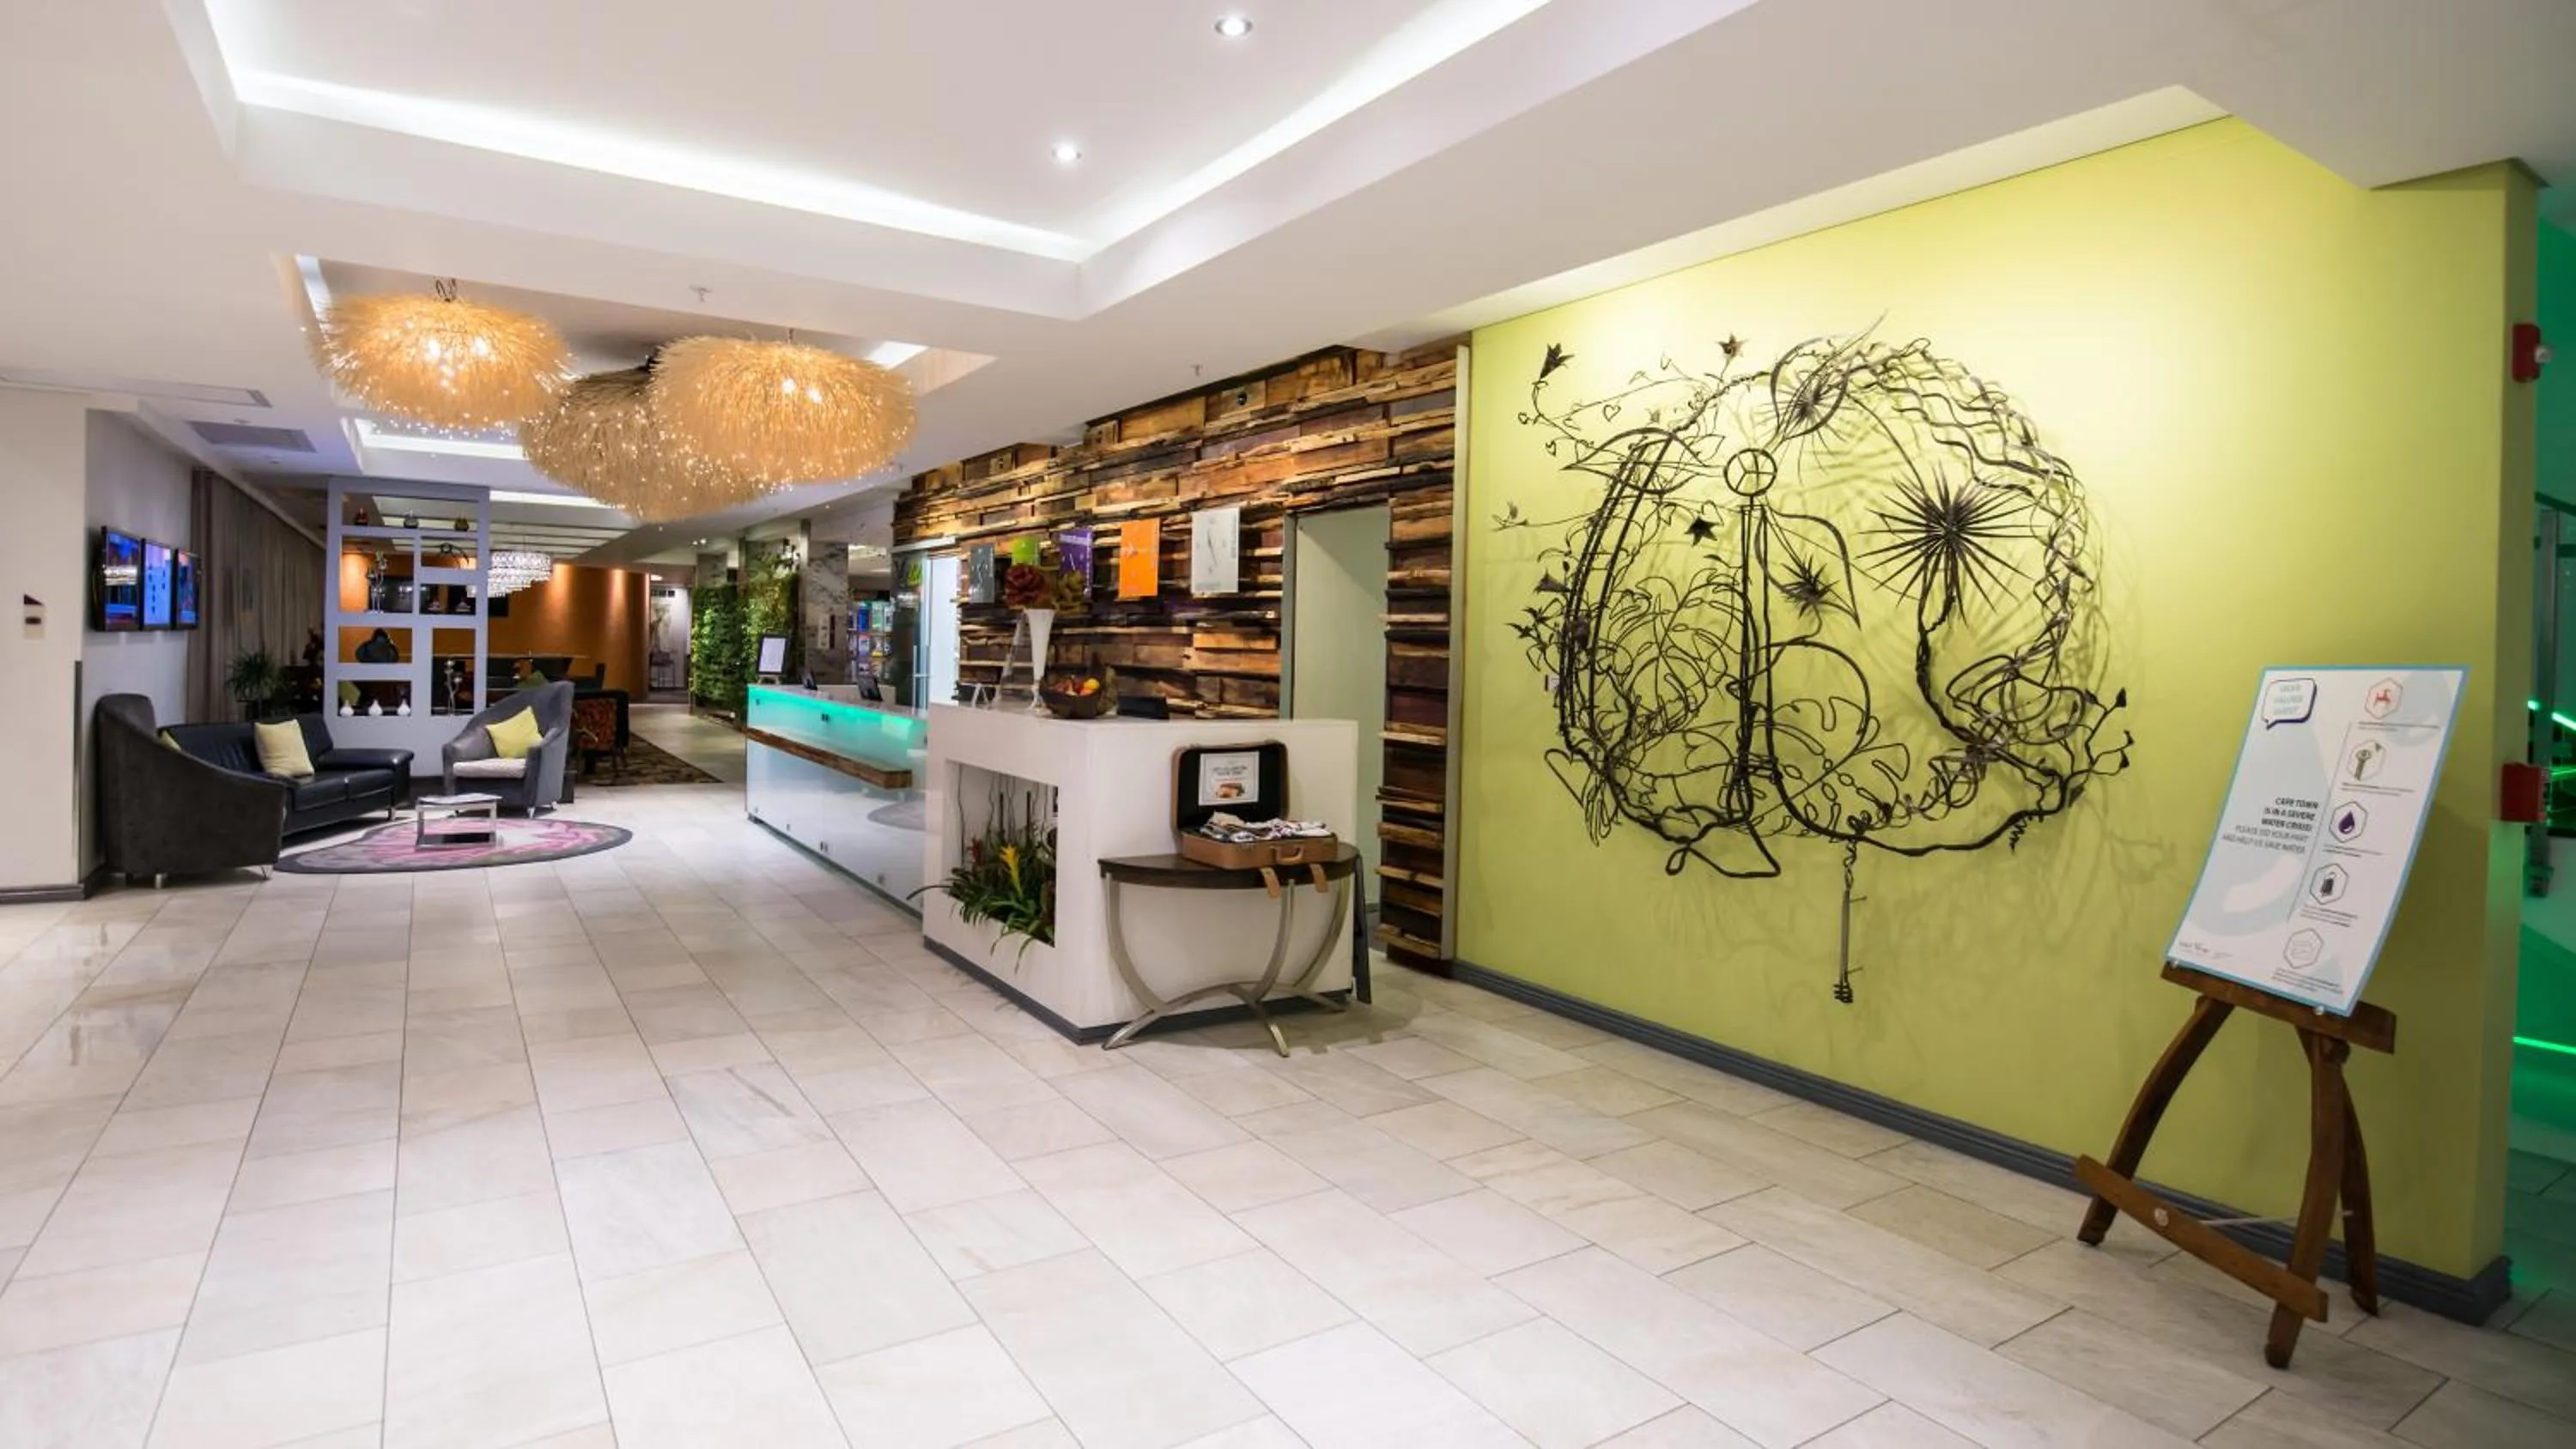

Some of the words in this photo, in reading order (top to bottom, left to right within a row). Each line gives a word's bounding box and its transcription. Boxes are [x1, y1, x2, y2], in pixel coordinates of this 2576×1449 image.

[2275, 797, 2294, 807] CAPE
[2295, 799, 2318, 809] TOWN
[2287, 809, 2316, 821] SEVERE
[2262, 818, 2286, 828] WATER
[2272, 830, 2290, 840] YOUR
